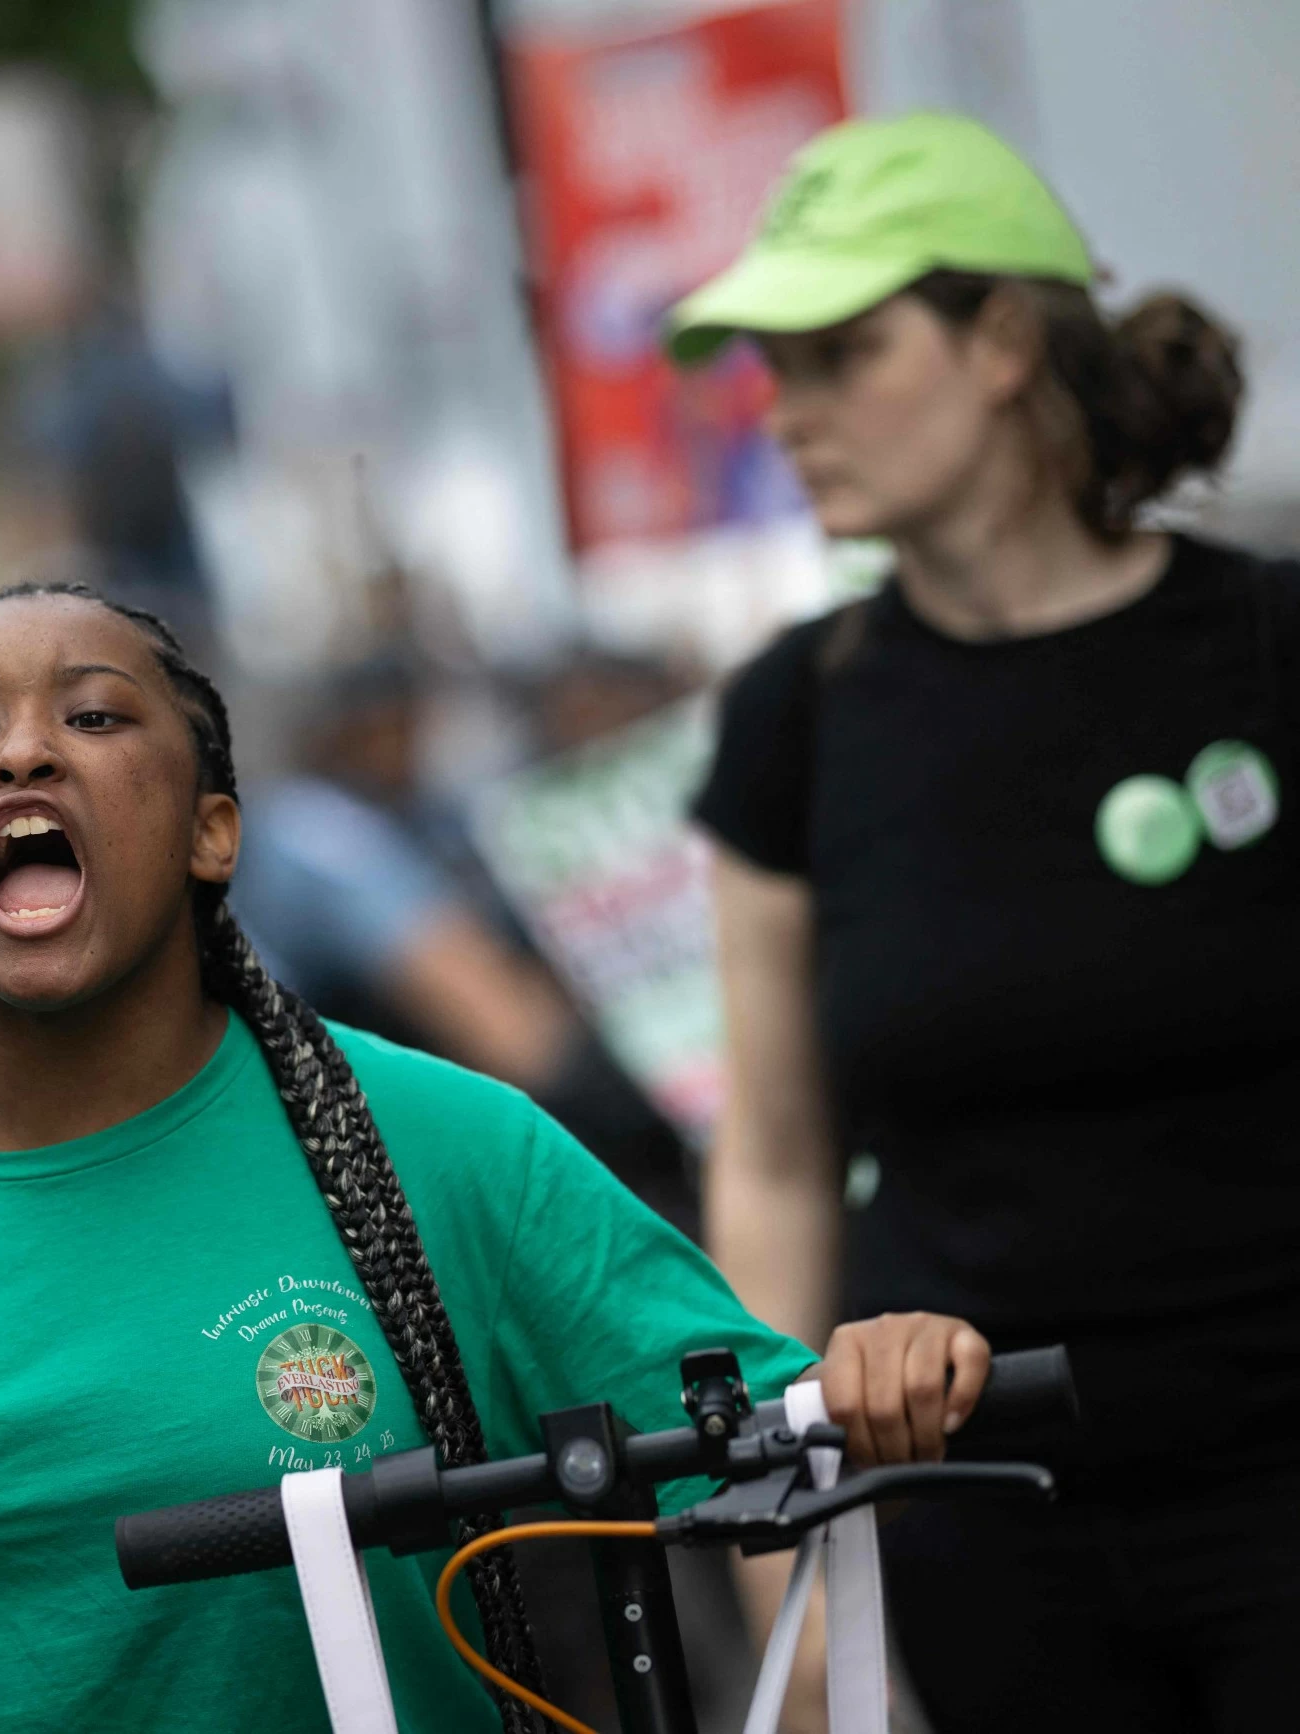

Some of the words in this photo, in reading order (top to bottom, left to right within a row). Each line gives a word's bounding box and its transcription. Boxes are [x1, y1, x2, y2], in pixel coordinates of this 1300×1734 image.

[201, 1287, 273, 1340] Intrinsic
[237, 1308, 288, 1342] Drama
[277, 1373, 360, 1393] EVERLASTING
[268, 1445, 314, 1471] May
[379, 1429, 395, 1451] 25
